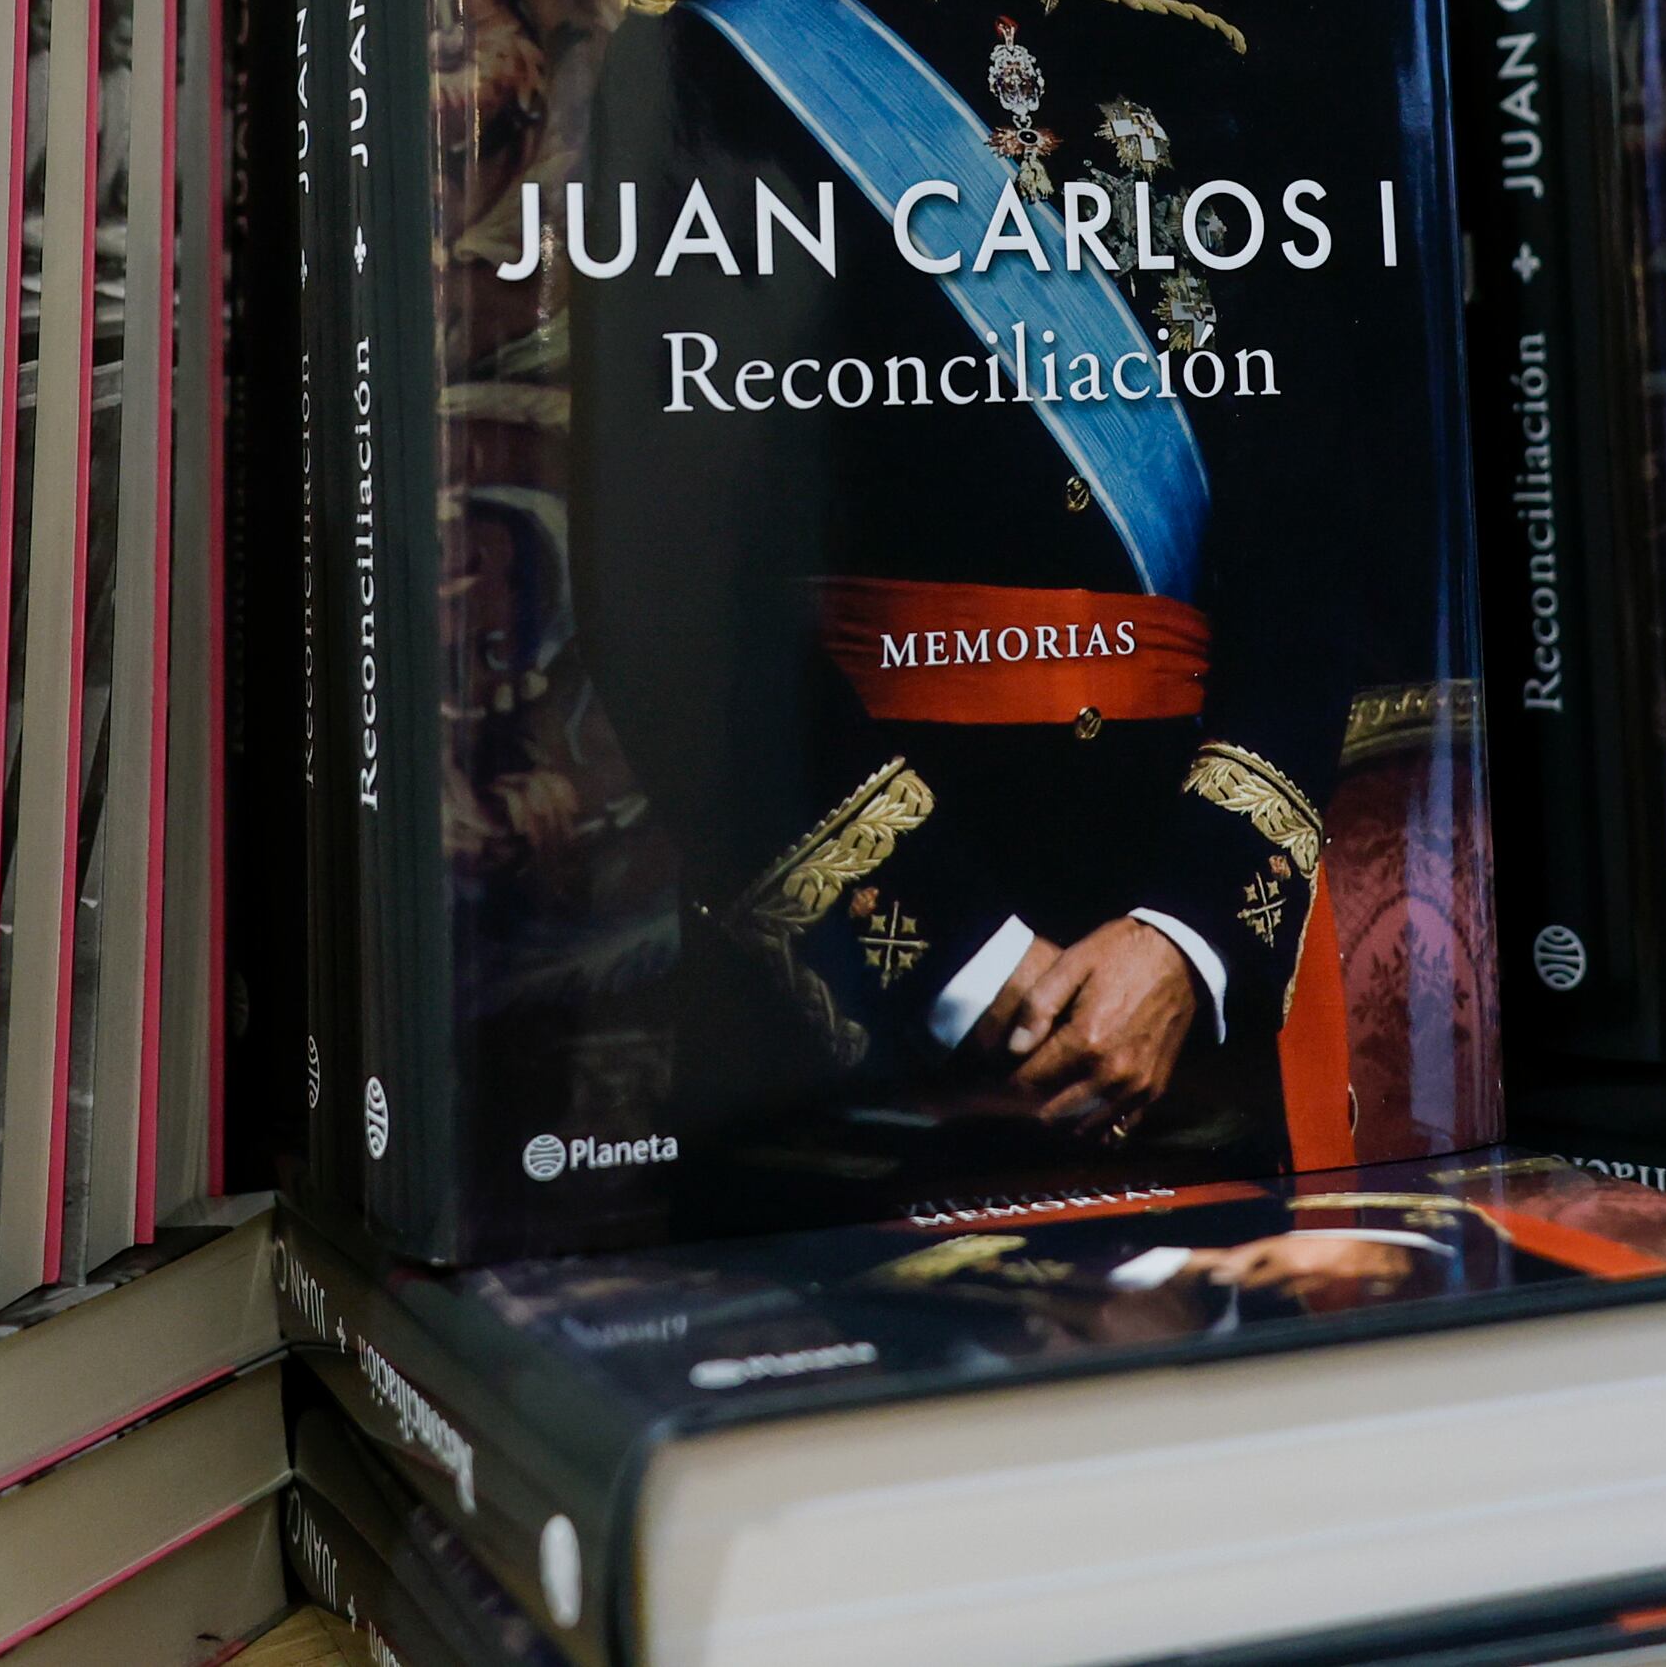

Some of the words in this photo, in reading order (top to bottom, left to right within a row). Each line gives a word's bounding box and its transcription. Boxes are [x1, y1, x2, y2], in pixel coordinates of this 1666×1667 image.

[1501, 32, 1545, 200] JUAN
[496, 179, 837, 283] JUAN
[893, 178, 1333, 275] CARLOS
[1379, 179, 1400, 268] I
[662, 321, 1282, 414] Reconciliación
[352, 334, 380, 813] Reconciliación
[1508, 332, 1564, 716] Reconciliación
[879, 620, 1137, 670] MEMORIAS
[569, 1133, 679, 1170] Planeta
